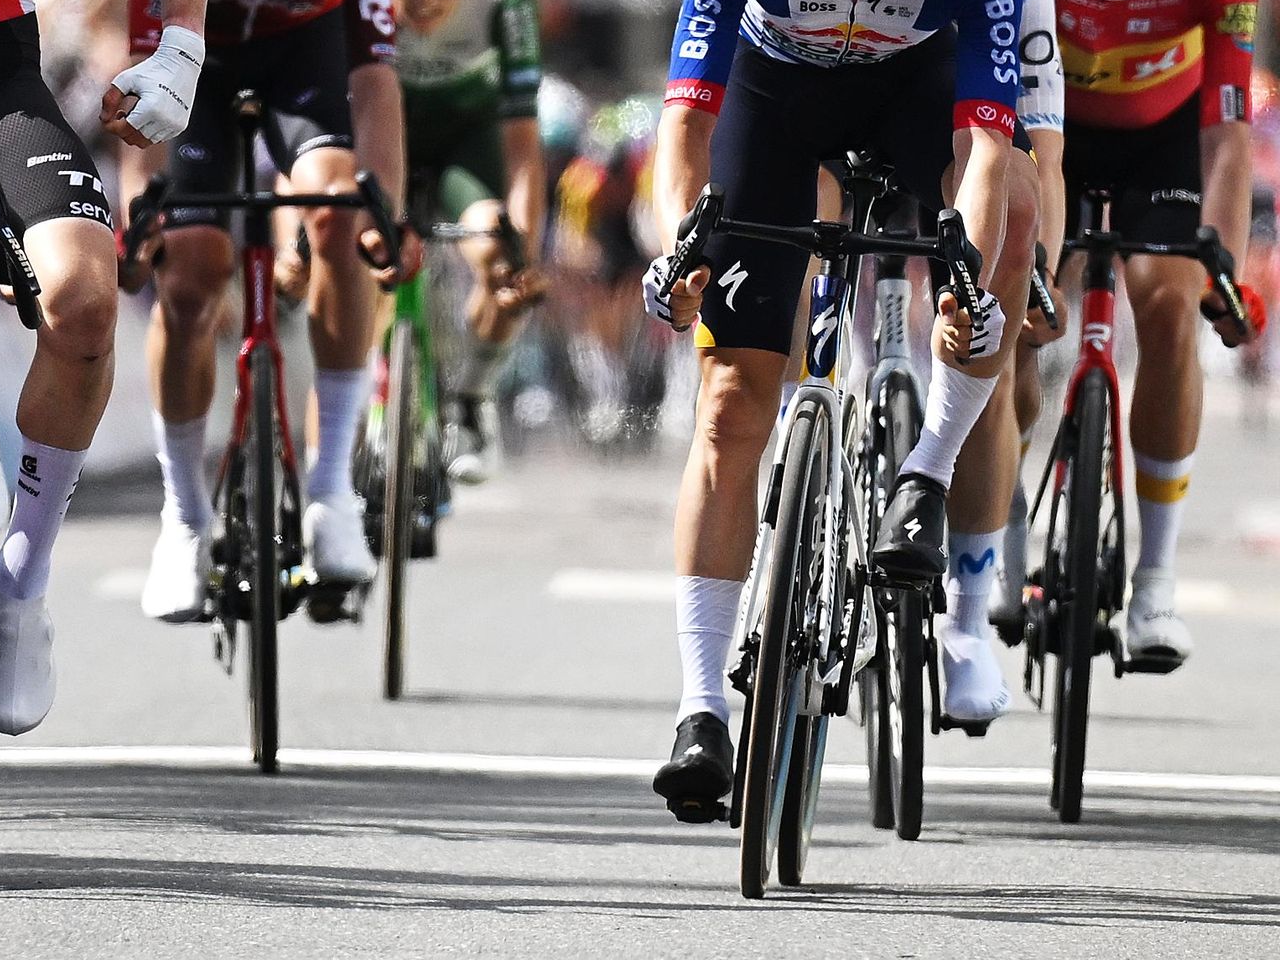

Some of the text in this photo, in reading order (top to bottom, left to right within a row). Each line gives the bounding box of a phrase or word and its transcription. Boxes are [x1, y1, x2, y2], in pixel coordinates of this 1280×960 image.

[800, 1, 837, 12] BOSS
[1, 226, 34, 278] SRAM
[956, 260, 980, 313] SRAM
